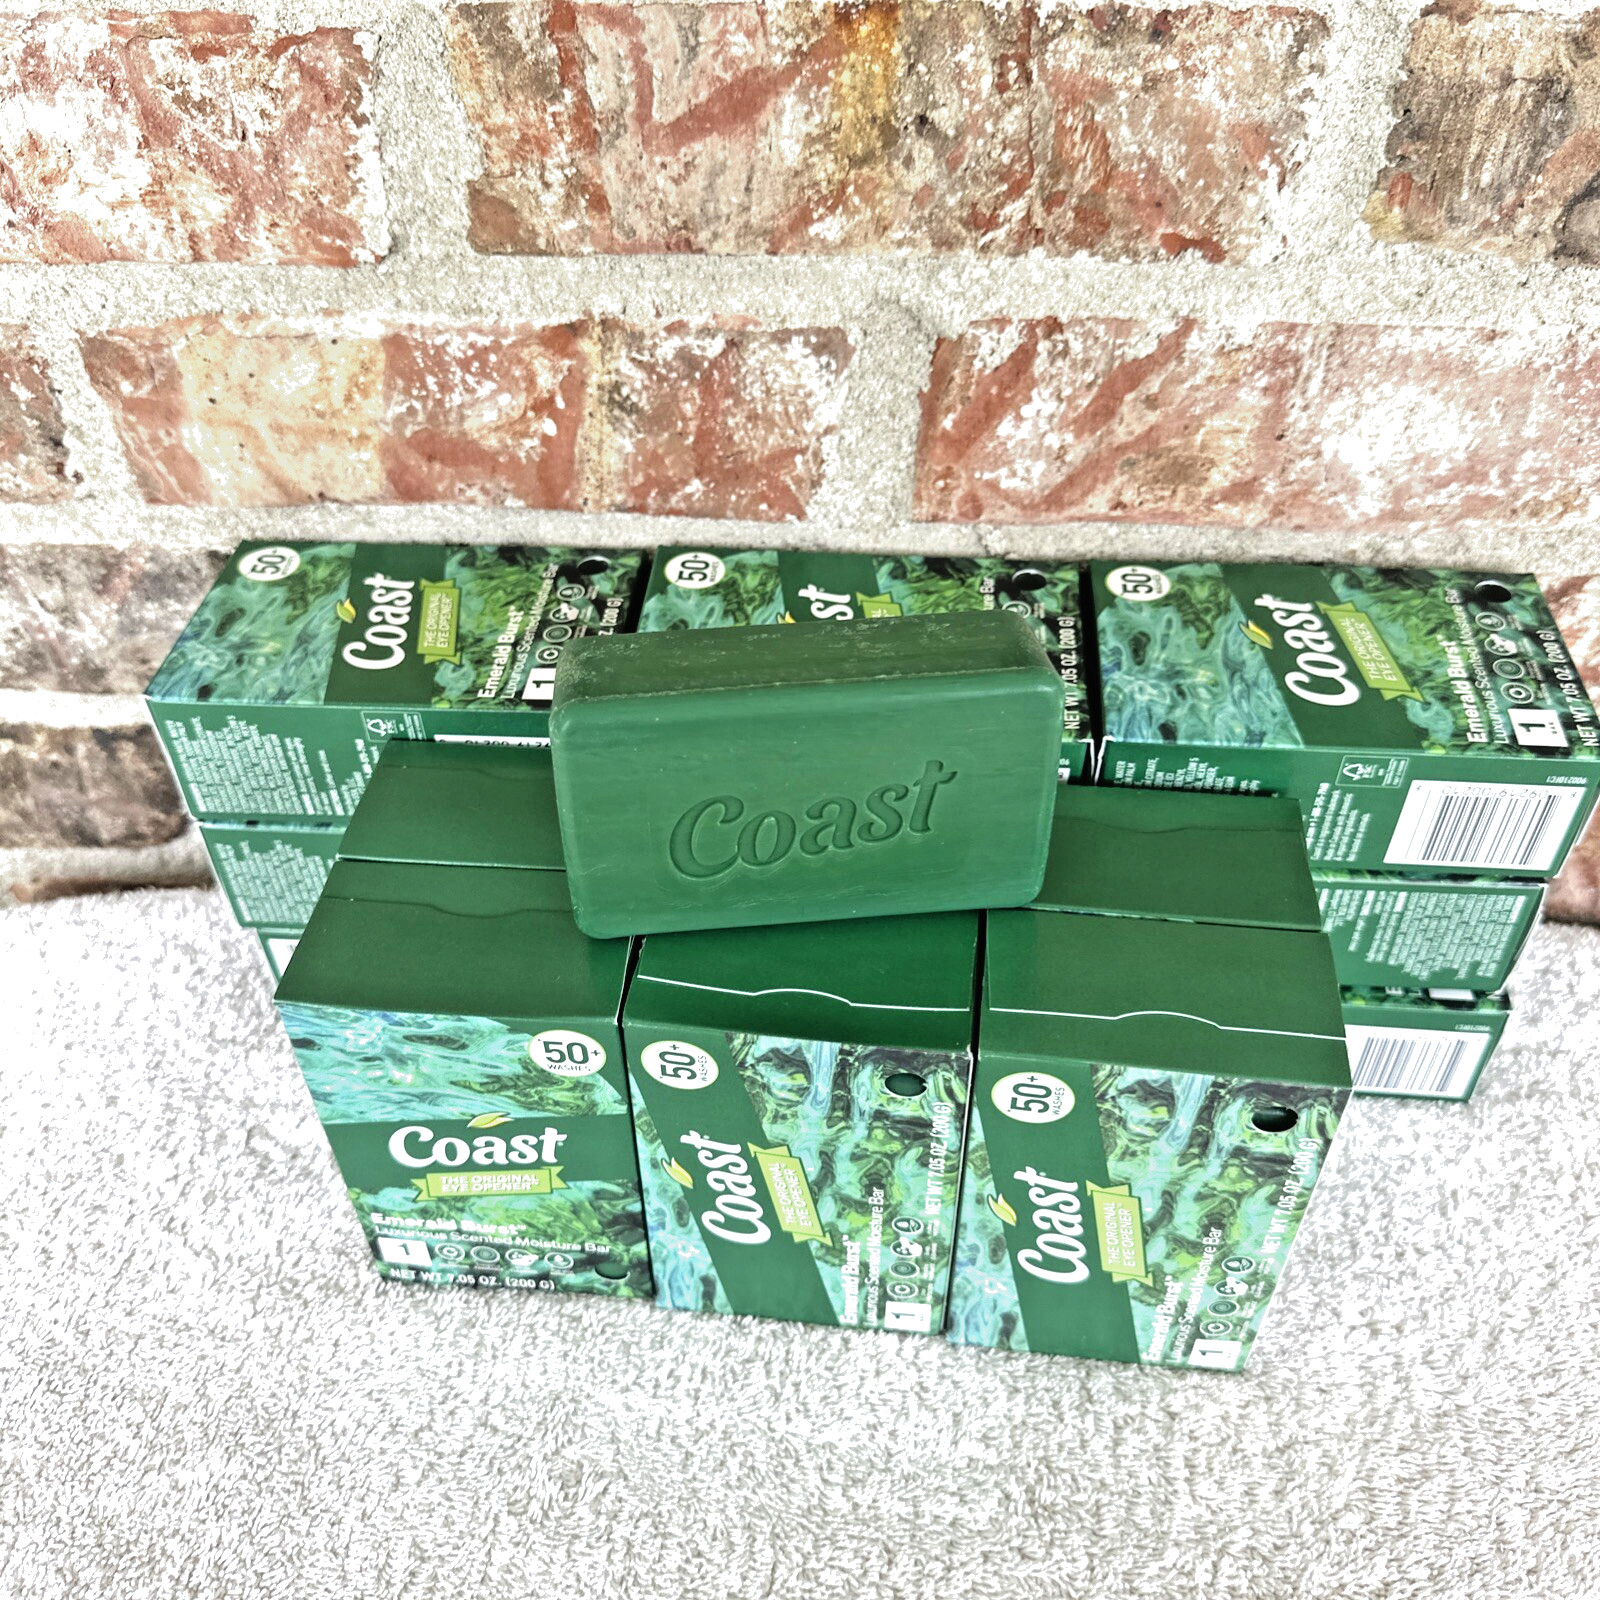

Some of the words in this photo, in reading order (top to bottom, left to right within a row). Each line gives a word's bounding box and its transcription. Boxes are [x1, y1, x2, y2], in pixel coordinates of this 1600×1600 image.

[343, 572, 415, 670] Coast
[424, 630, 438, 648] THE
[1059, 628, 1077, 649] (200
[1337, 617, 1371, 660] ORIGINAL
[1354, 621, 1385, 661] OPENER
[1254, 594, 1359, 707] Coast
[1543, 642, 1568, 663] (200
[477, 645, 513, 698] Emerald
[502, 653, 528, 699] Luxurious
[1362, 661, 1383, 681] THE
[1377, 662, 1398, 682] EYE
[1466, 646, 1491, 689] Scented
[1559, 682, 1582, 703] 7.05
[1064, 709, 1080, 729] NET
[1450, 680, 1489, 743] Emerald
[1481, 689, 1509, 744] Luxurious
[1569, 705, 1592, 722] WT
[1518, 722, 1546, 734] 1
[1576, 724, 1600, 747] NET
[668, 759, 958, 881] Coast
[547, 1063, 592, 1073] WASHES
[1010, 1075, 1052, 1114] 50+
[1052, 1087, 1065, 1115] WASHES
[932, 1101, 953, 1113] G)
[930, 1115, 951, 1138] (200
[388, 1126, 567, 1167] Coast
[1299, 1137, 1322, 1150] G)
[1287, 1151, 1314, 1175] (200
[441, 1175, 468, 1185] THE
[471, 1173, 537, 1184] ORIGINAL
[441, 1184, 468, 1193] EYE
[471, 1182, 532, 1192] OPENER
[680, 1130, 771, 1245] Coast
[768, 1162, 792, 1206] ORIGINAL
[868, 1187, 885, 1206] Bar
[371, 1212, 457, 1231] Emerald
[781, 1206, 797, 1225] THE
[795, 1207, 813, 1227] EYE
[1013, 1166, 1090, 1284] Coast
[1105, 1201, 1117, 1245] ORIGINAL
[375, 1226, 448, 1241] Luxurious
[449, 1232, 513, 1246] Scented
[515, 1237, 582, 1252] Moisture
[585, 1241, 612, 1253] Bar
[1119, 1208, 1134, 1248] OPENER
[1202, 1227, 1223, 1246] Bar
[398, 1243, 411, 1256] 1
[1108, 1245, 1120, 1265] THE
[1122, 1247, 1136, 1267] EYE
[391, 1268, 416, 1281] NET
[421, 1271, 443, 1282] WT
[505, 1275, 537, 1289] (200
[538, 1278, 556, 1291] G)
